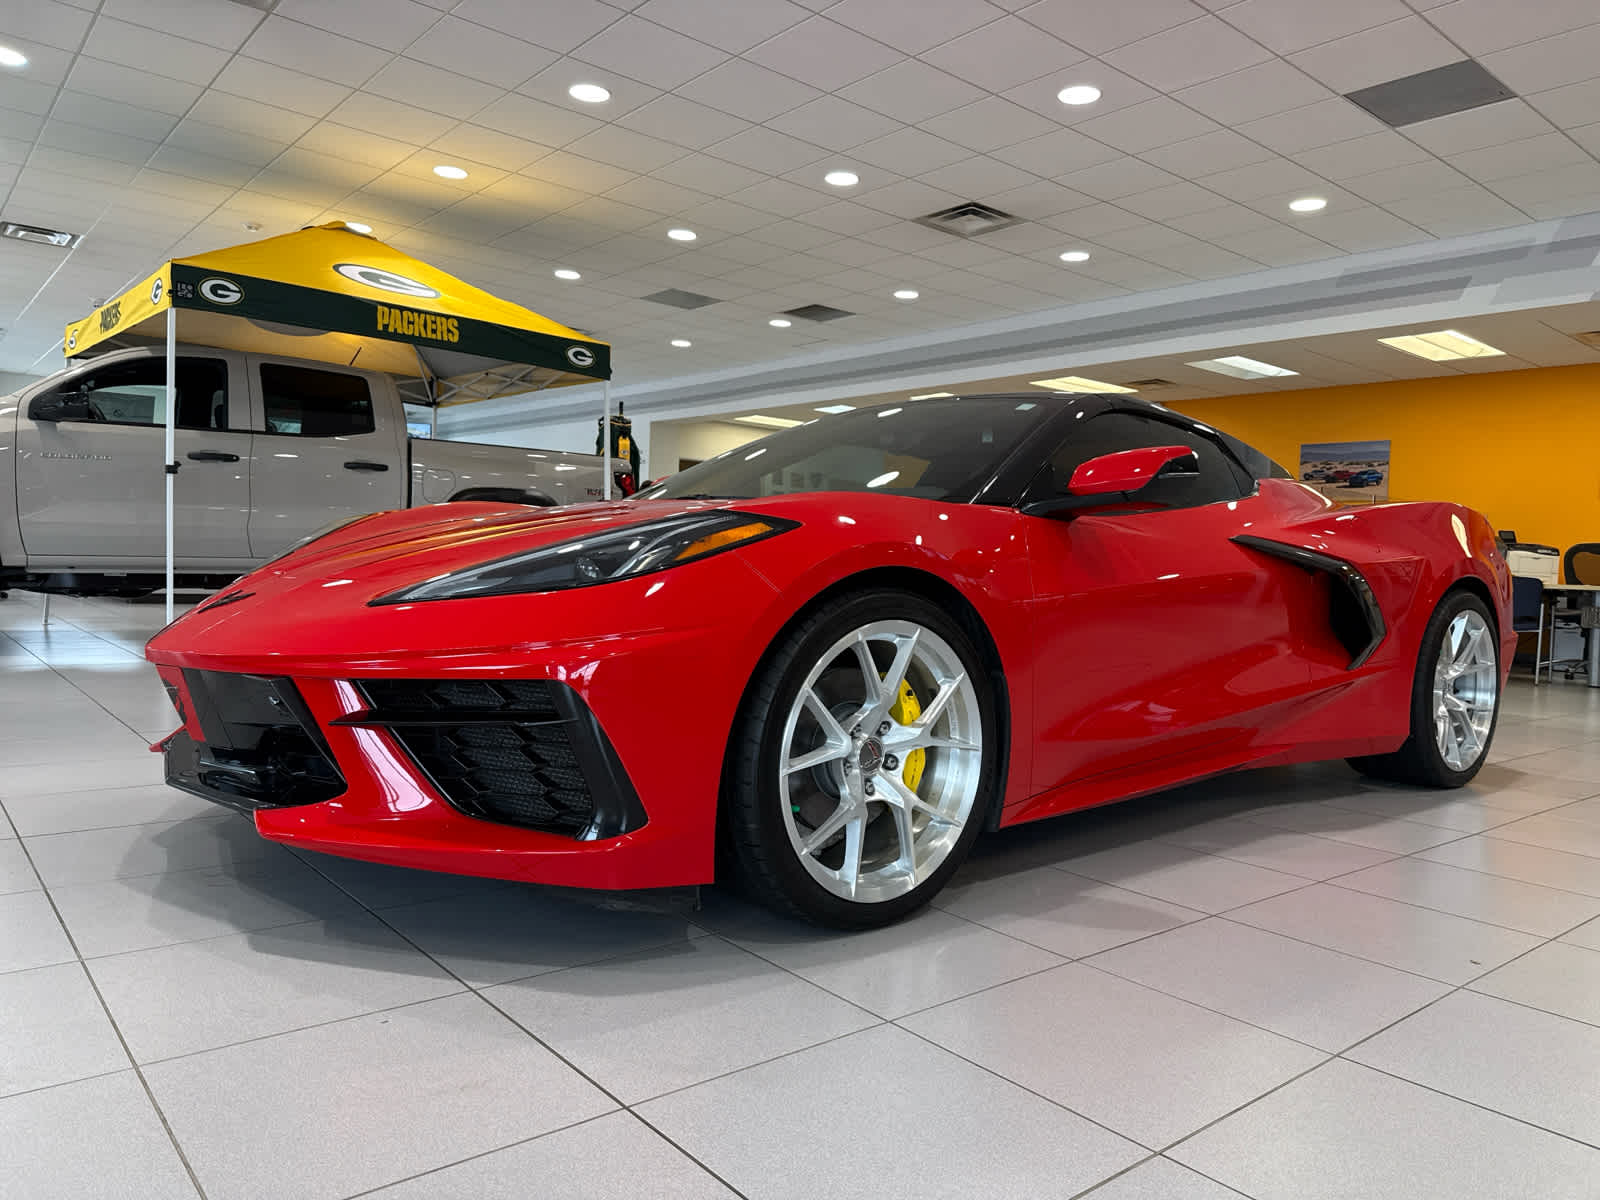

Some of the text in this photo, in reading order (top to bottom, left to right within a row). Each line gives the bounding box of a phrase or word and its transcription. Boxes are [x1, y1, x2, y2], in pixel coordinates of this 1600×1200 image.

[201, 279, 241, 303] G
[377, 305, 460, 343] PACKERS
[568, 347, 593, 366] G
